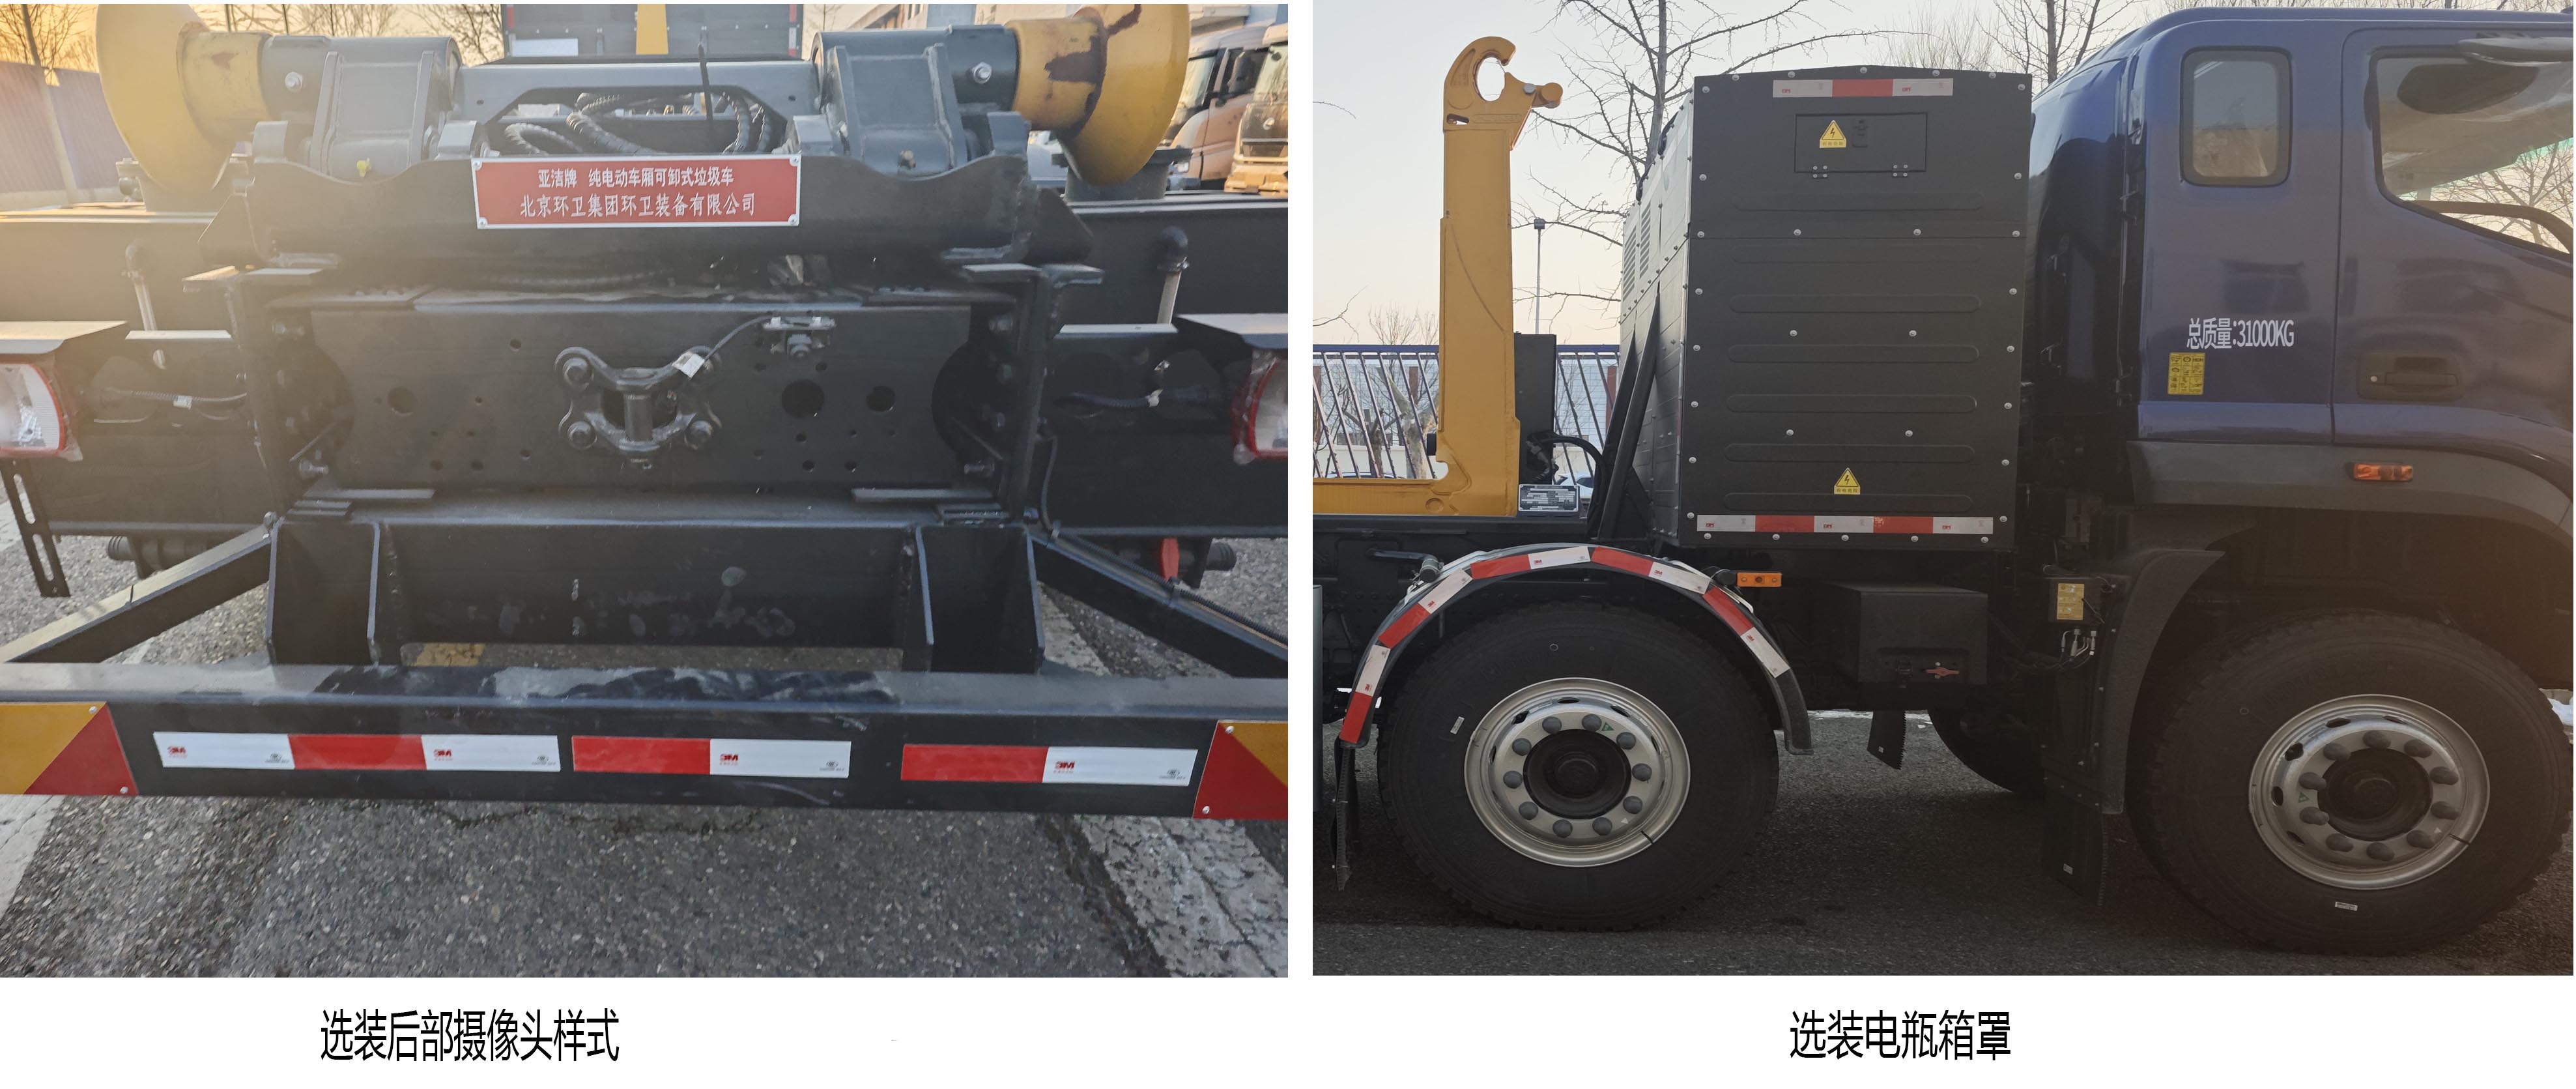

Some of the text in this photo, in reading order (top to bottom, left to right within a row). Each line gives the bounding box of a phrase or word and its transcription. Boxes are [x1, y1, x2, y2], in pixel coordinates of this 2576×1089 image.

[538, 167, 734, 188] 亚洁牌 纯电动车厢可卸式垃圾车
[520, 192, 755, 218] 北京环卫集团环卫装备有限公司
[2186, 317, 2294, 349] 总质量:31000KG
